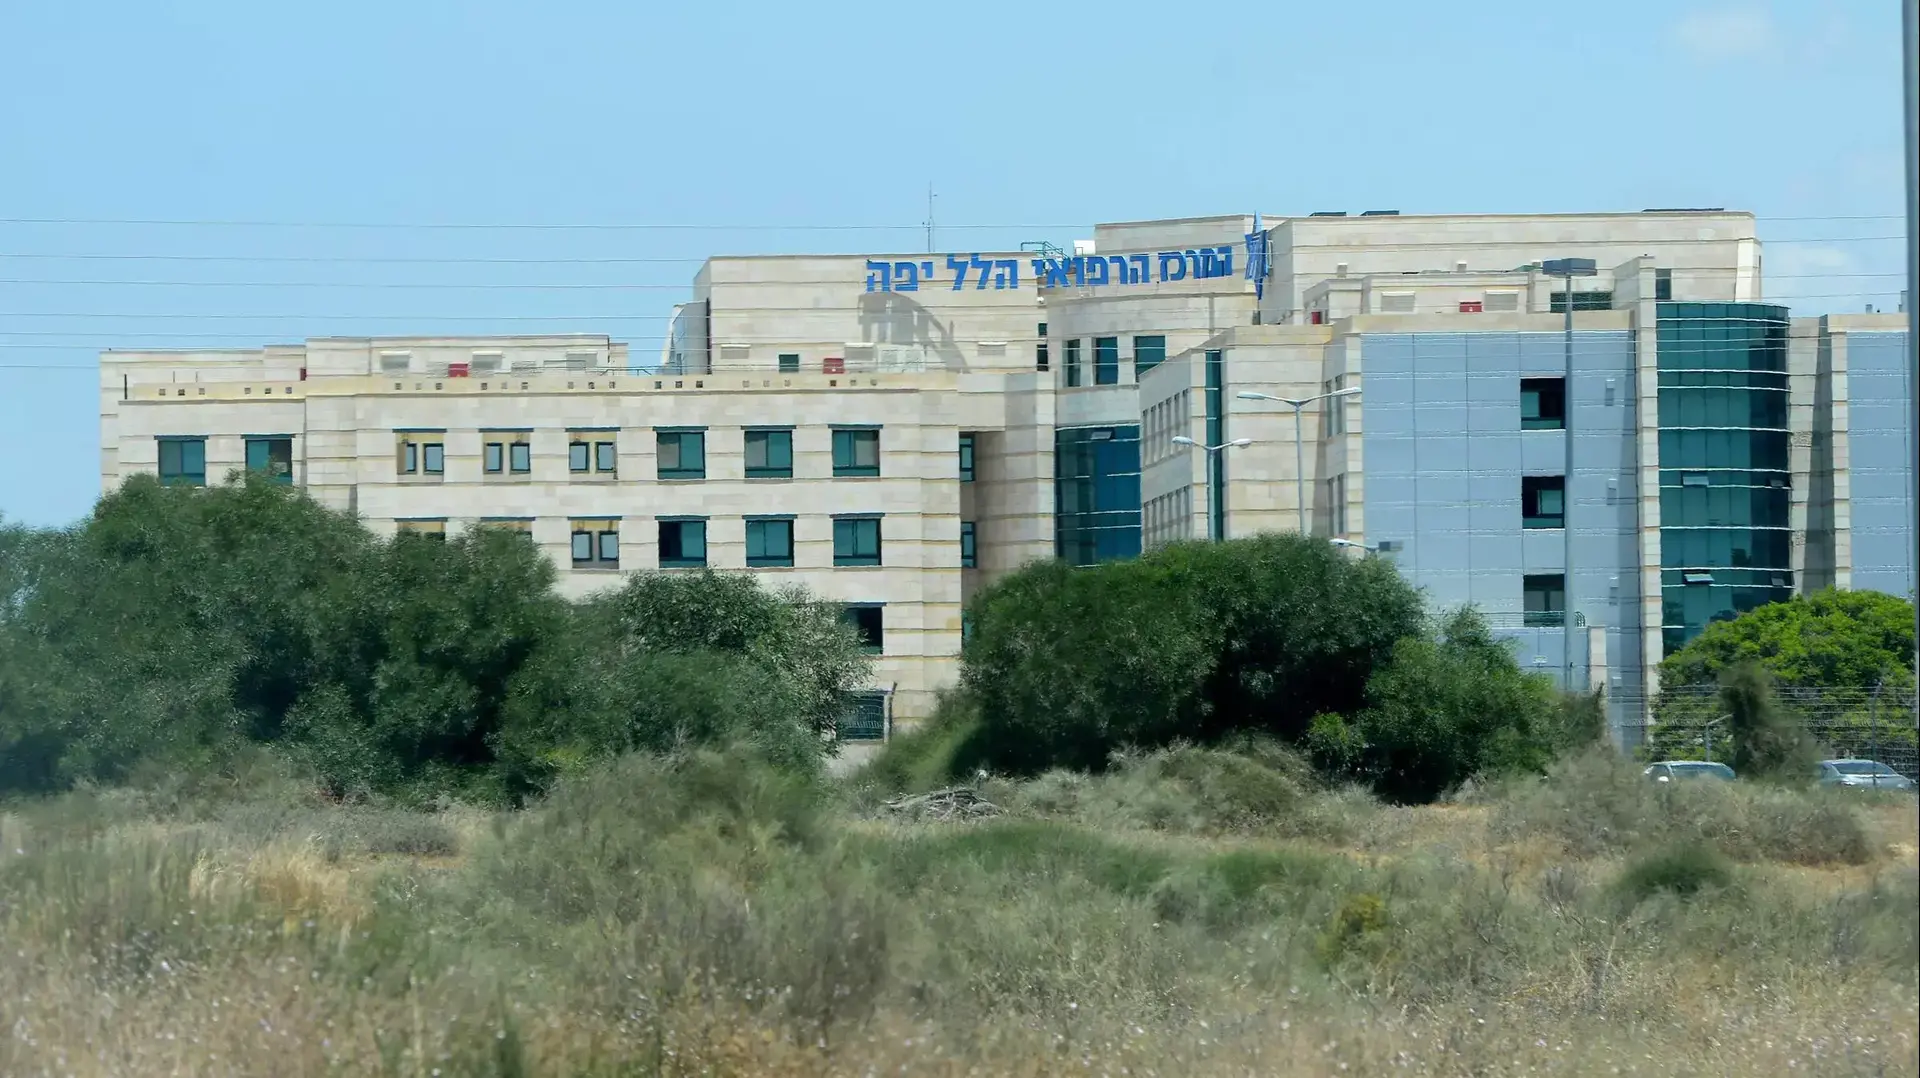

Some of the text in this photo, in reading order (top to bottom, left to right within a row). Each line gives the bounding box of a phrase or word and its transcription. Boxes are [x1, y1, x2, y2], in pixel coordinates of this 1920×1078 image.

[867, 261, 934, 292] יפה
[946, 253, 1018, 290] הלל
[1031, 251, 1150, 287] הרפואי
